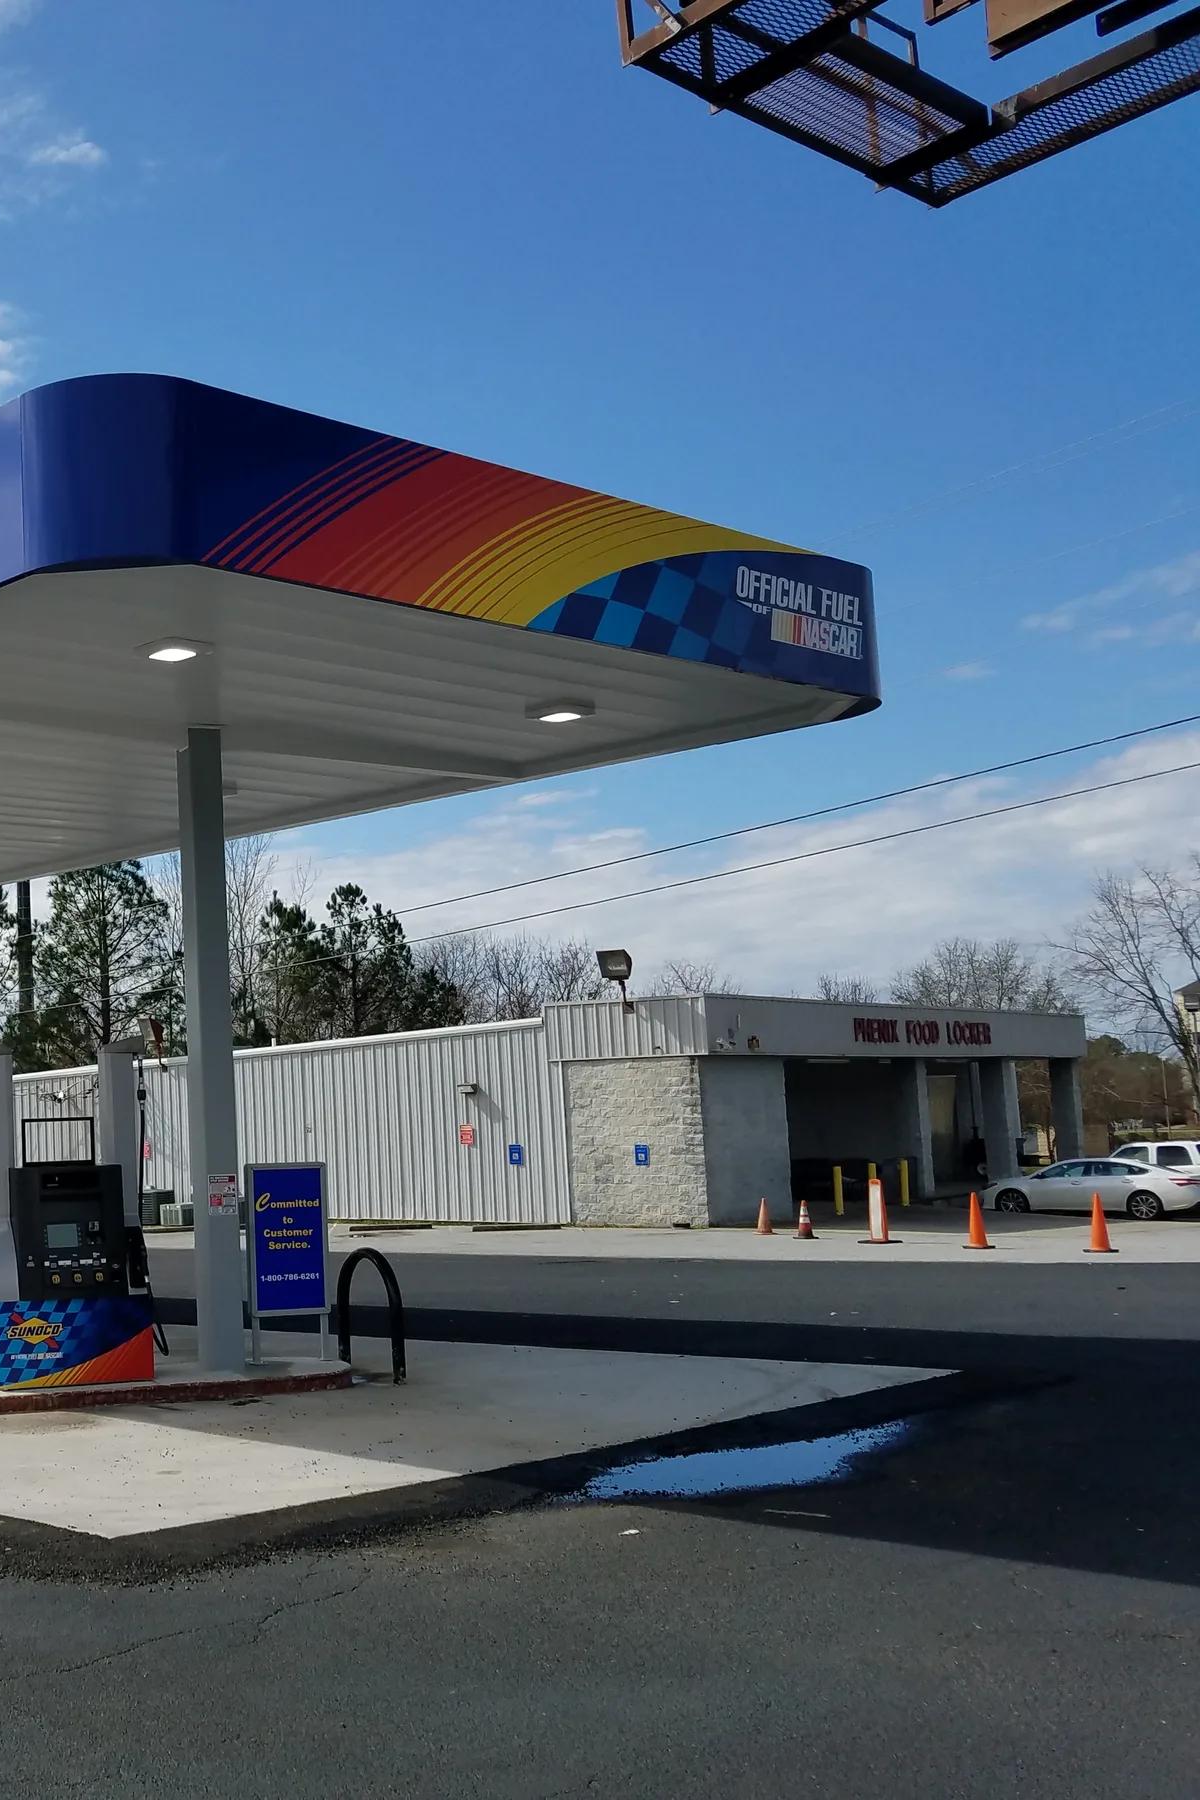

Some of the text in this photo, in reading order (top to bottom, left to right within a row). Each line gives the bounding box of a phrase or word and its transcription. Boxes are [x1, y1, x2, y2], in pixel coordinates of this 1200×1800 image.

[735, 565, 864, 627] OFFICIAL FUEL
[752, 603, 772, 615] OF
[801, 614, 858, 657] NASCAR
[905, 1019, 941, 1046] FOOD
[946, 1020, 992, 1046] LOCKER
[255, 1192, 320, 1212] Committed
[282, 1216, 293, 1224] to
[263, 1229, 313, 1237] Customer
[268, 1241, 311, 1250] Service.
[9, 1325, 61, 1338] SUNOCO
